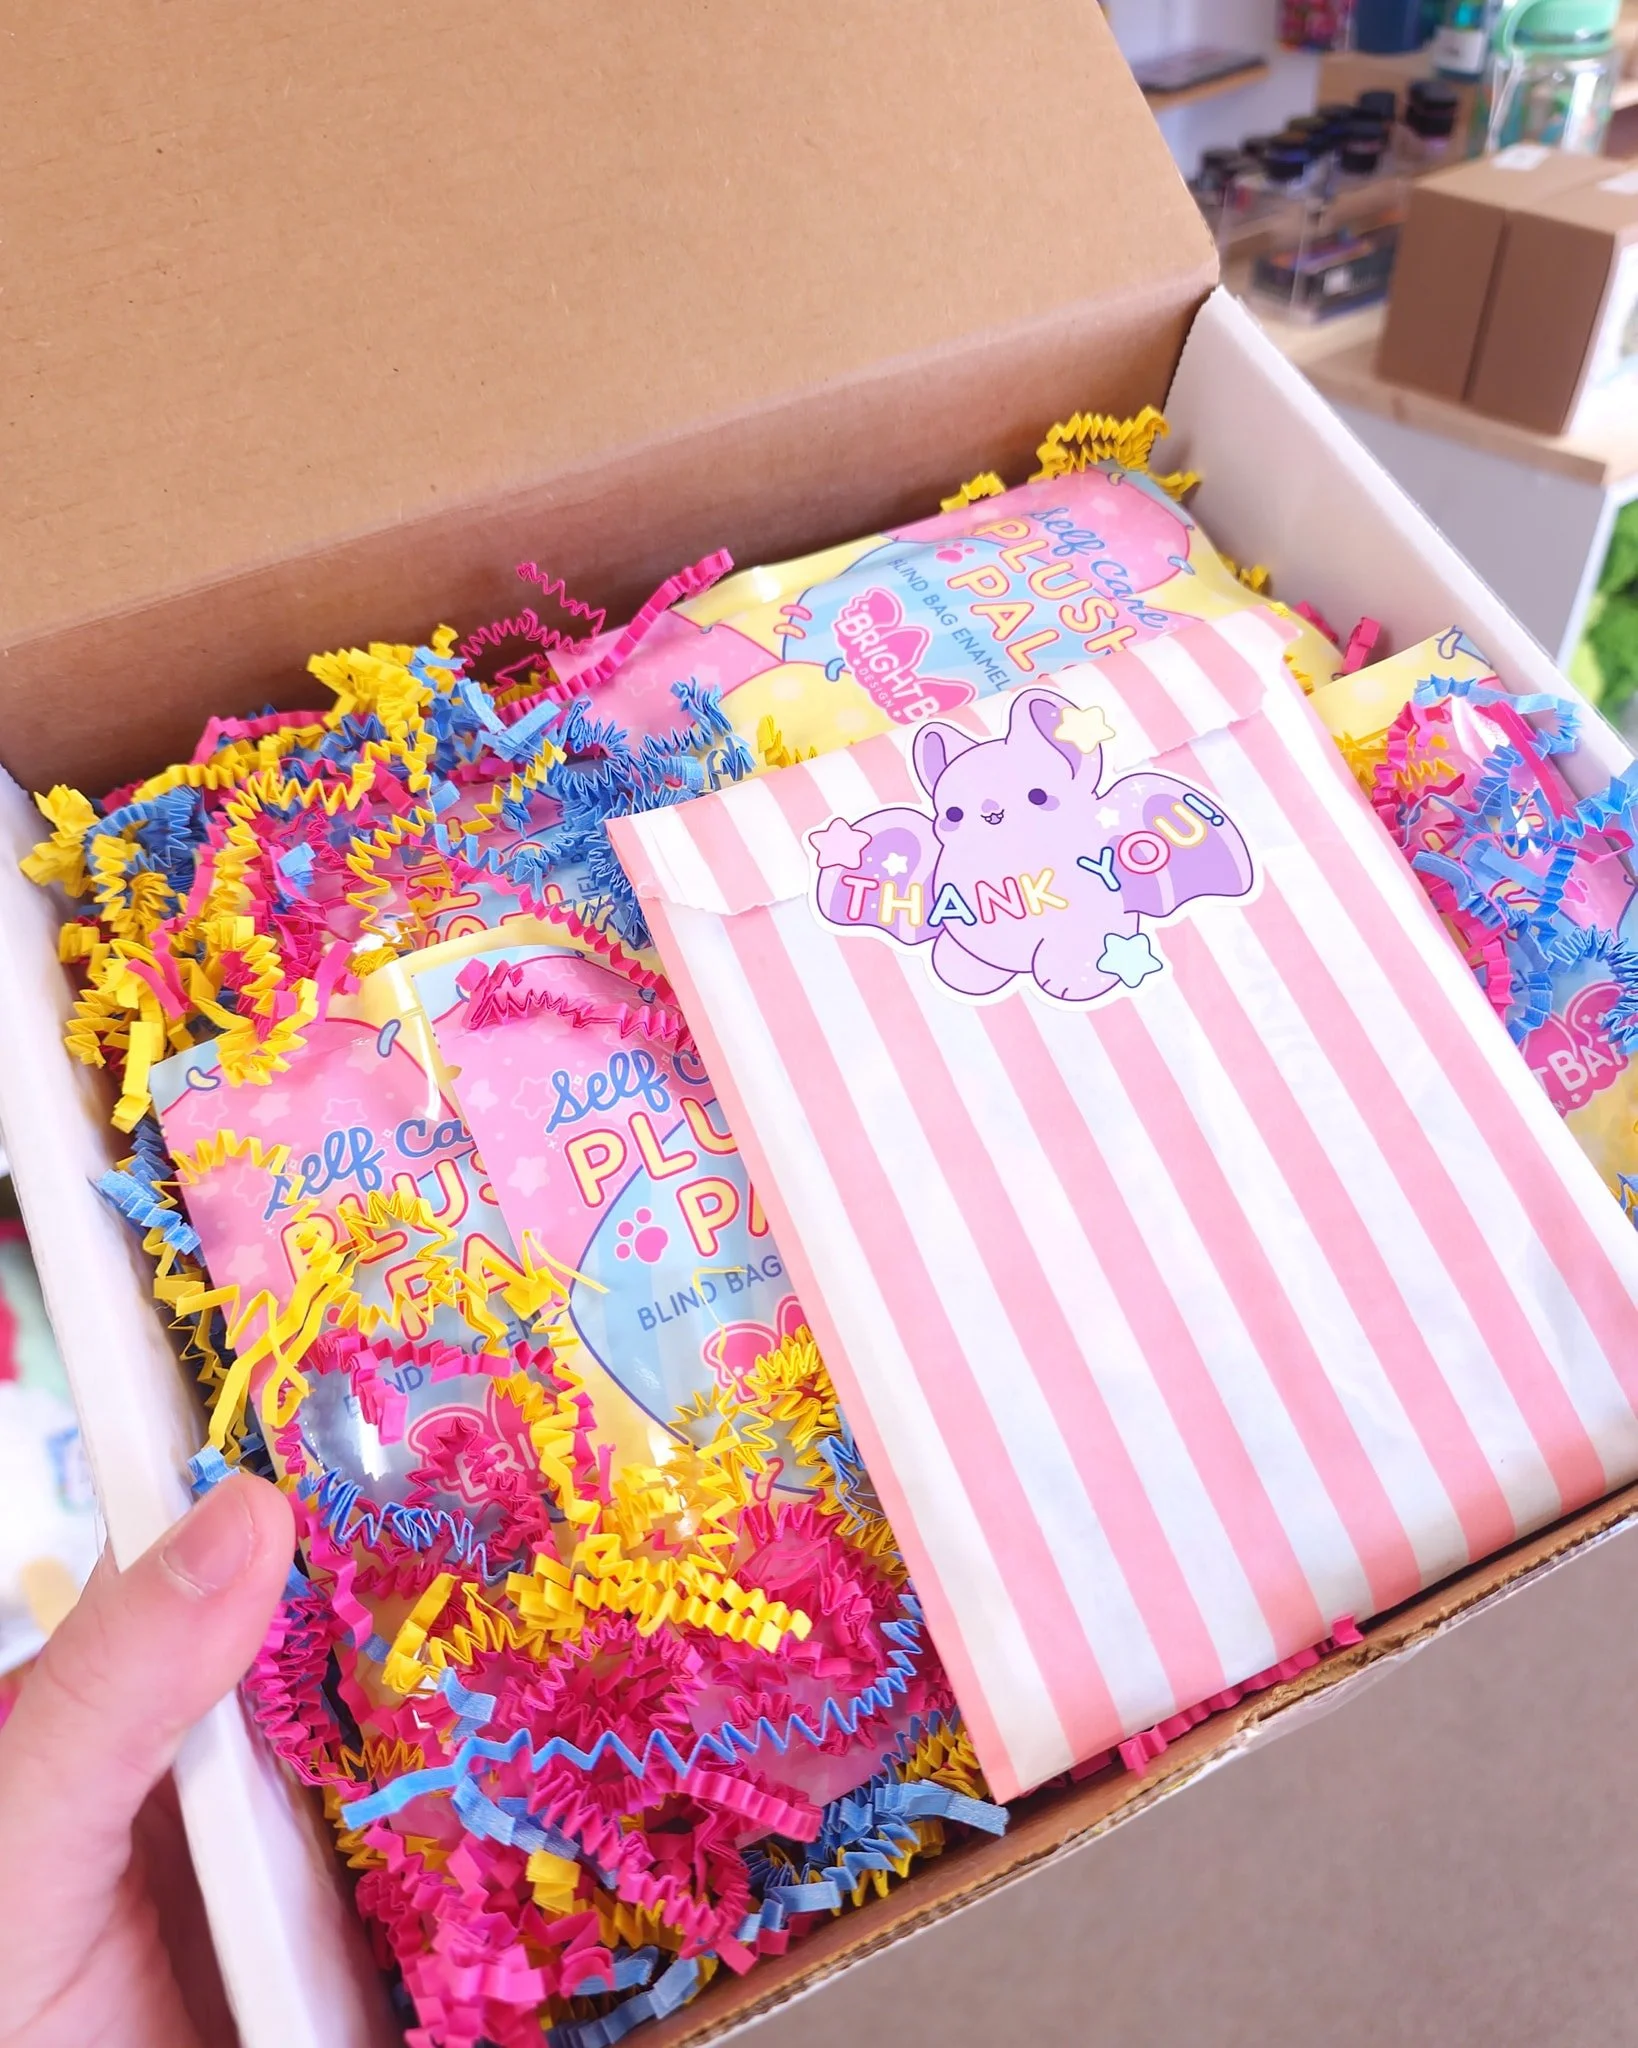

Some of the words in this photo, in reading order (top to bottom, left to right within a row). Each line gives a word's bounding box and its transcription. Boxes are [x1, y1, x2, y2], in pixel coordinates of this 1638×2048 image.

[858, 666, 894, 707] DESIGN
[922, 593, 959, 627] BAG
[950, 627, 1011, 692] ENAMEL
[842, 868, 1069, 928] THANK
[1077, 793, 1224, 892] YOU!
[636, 1279, 717, 1332] BLIND
[727, 1254, 783, 1296] BAG
